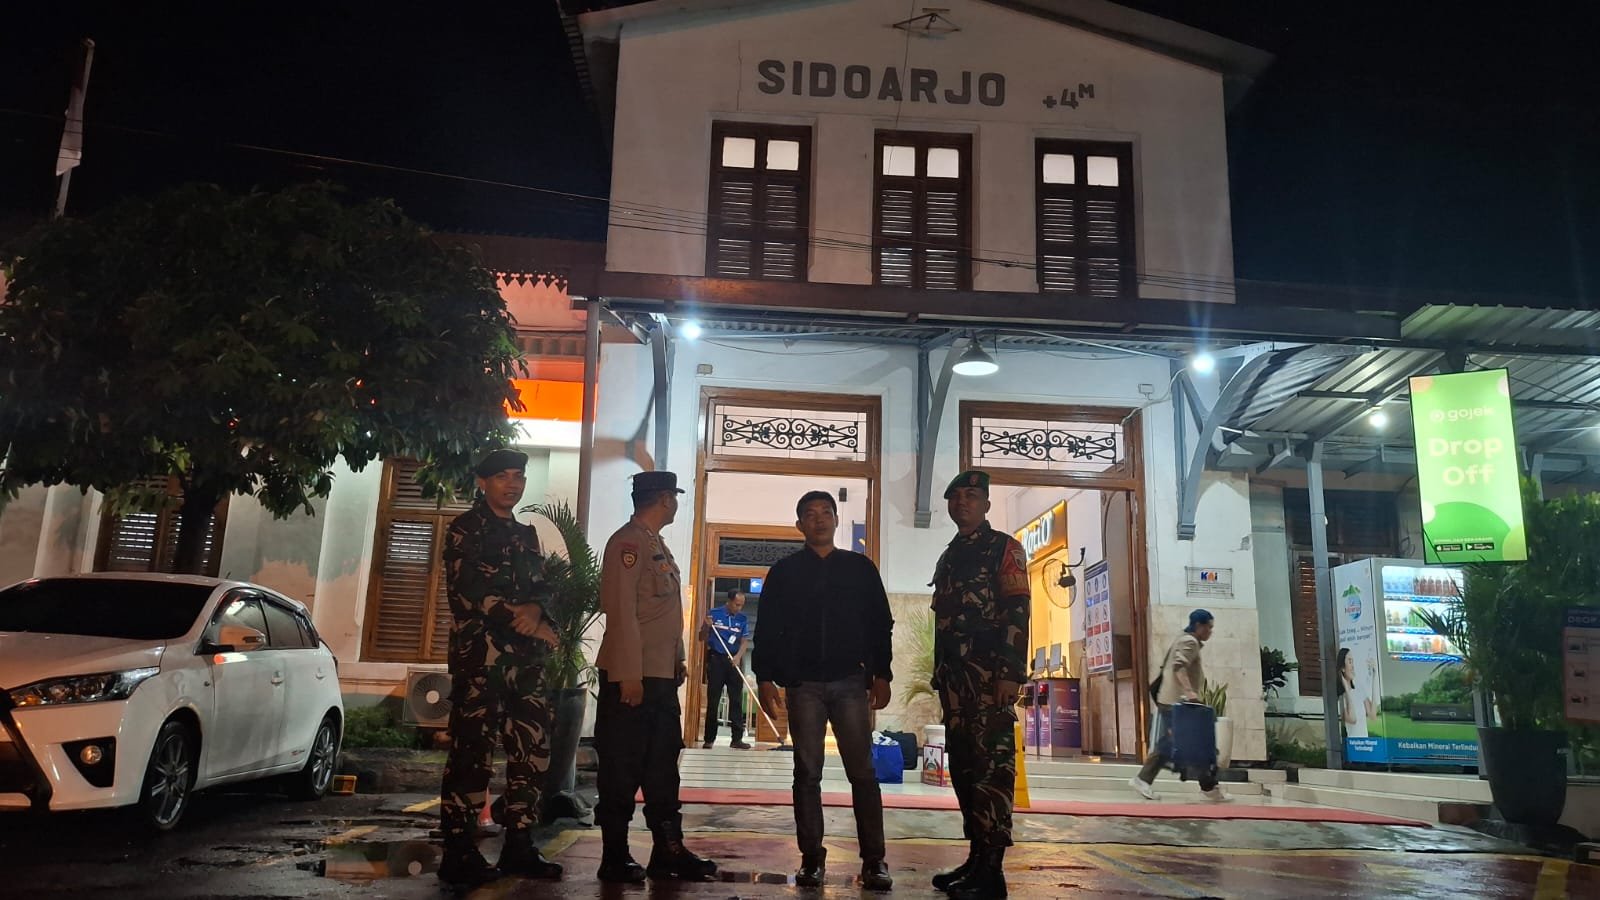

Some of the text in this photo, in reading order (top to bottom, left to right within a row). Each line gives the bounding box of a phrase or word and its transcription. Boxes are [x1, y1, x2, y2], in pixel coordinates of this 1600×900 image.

[757, 59, 1006, 107] SIDOARJO
[1447, 406, 1495, 422] gojek
[1429, 438, 1503, 460] Drop
[1443, 464, 1494, 486] Off
